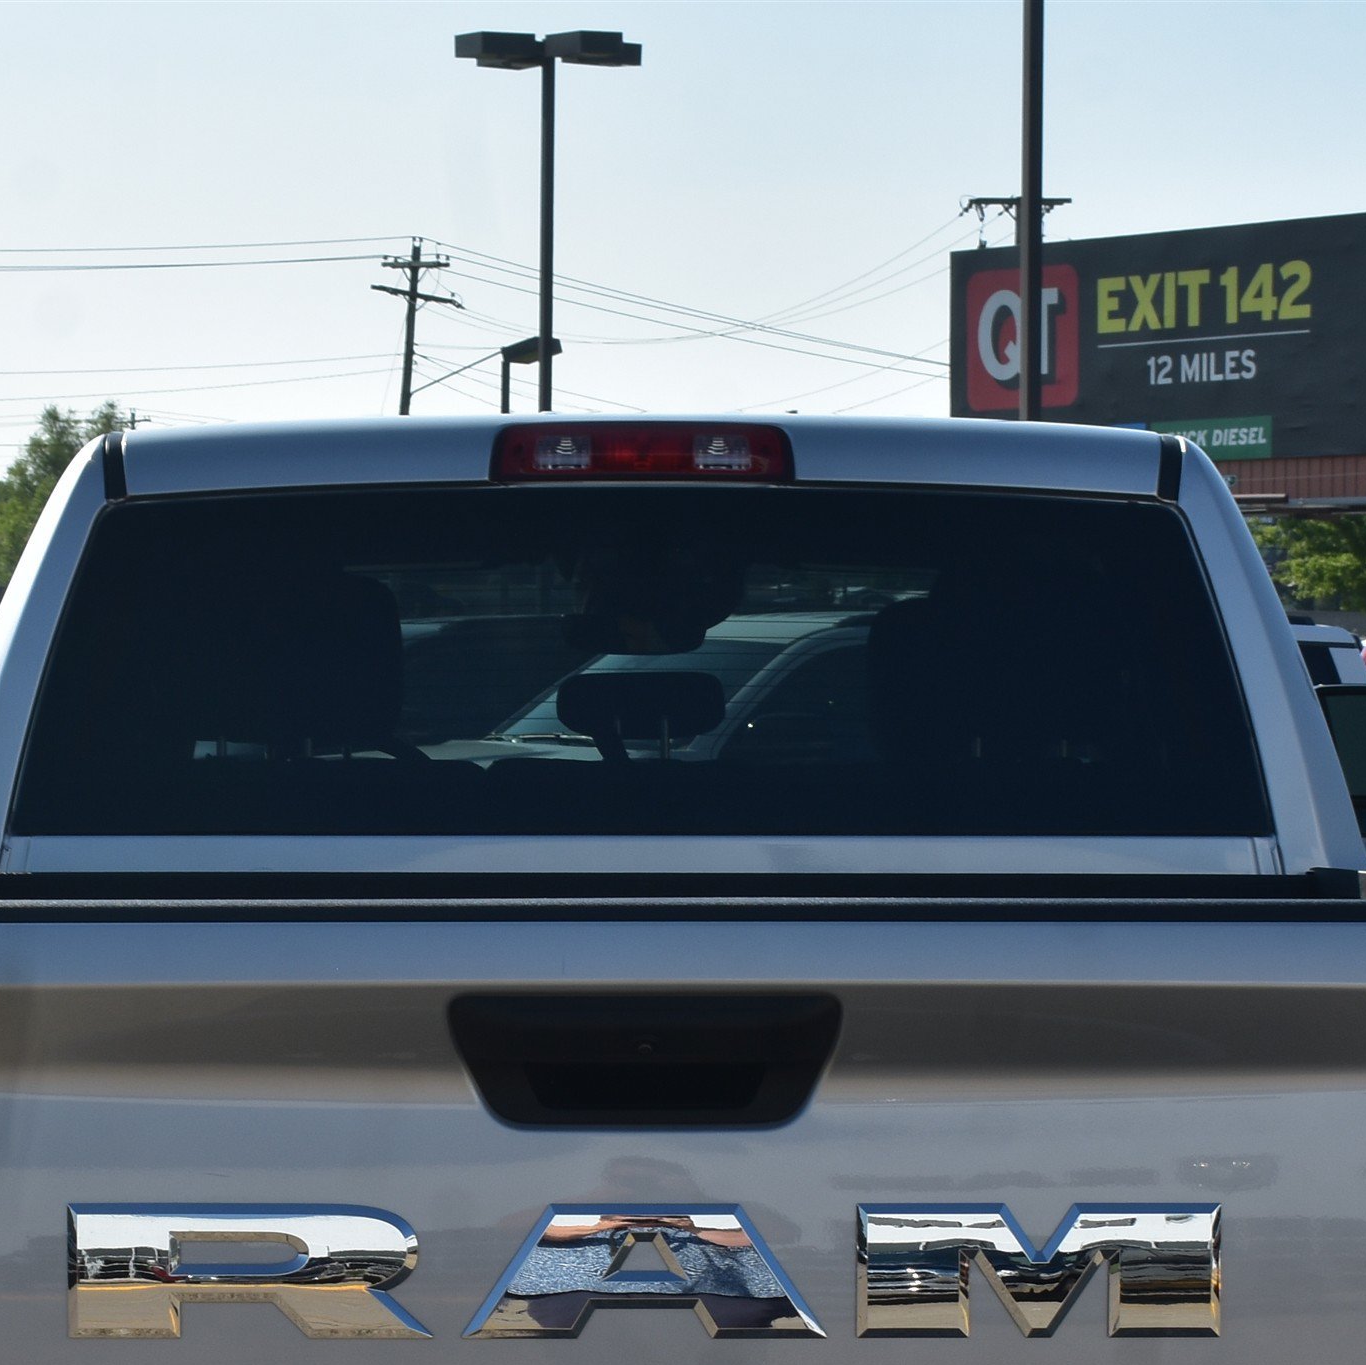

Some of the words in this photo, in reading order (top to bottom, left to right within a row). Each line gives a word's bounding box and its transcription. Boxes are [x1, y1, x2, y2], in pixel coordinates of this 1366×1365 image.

[1097, 269, 1210, 334] EXIT
[1220, 260, 1311, 323] 142
[1147, 355, 1173, 385] 12
[1180, 349, 1257, 383] MILES
[1211, 427, 1267, 446] DIESEL
[66, 1201, 1223, 1338] RAM
